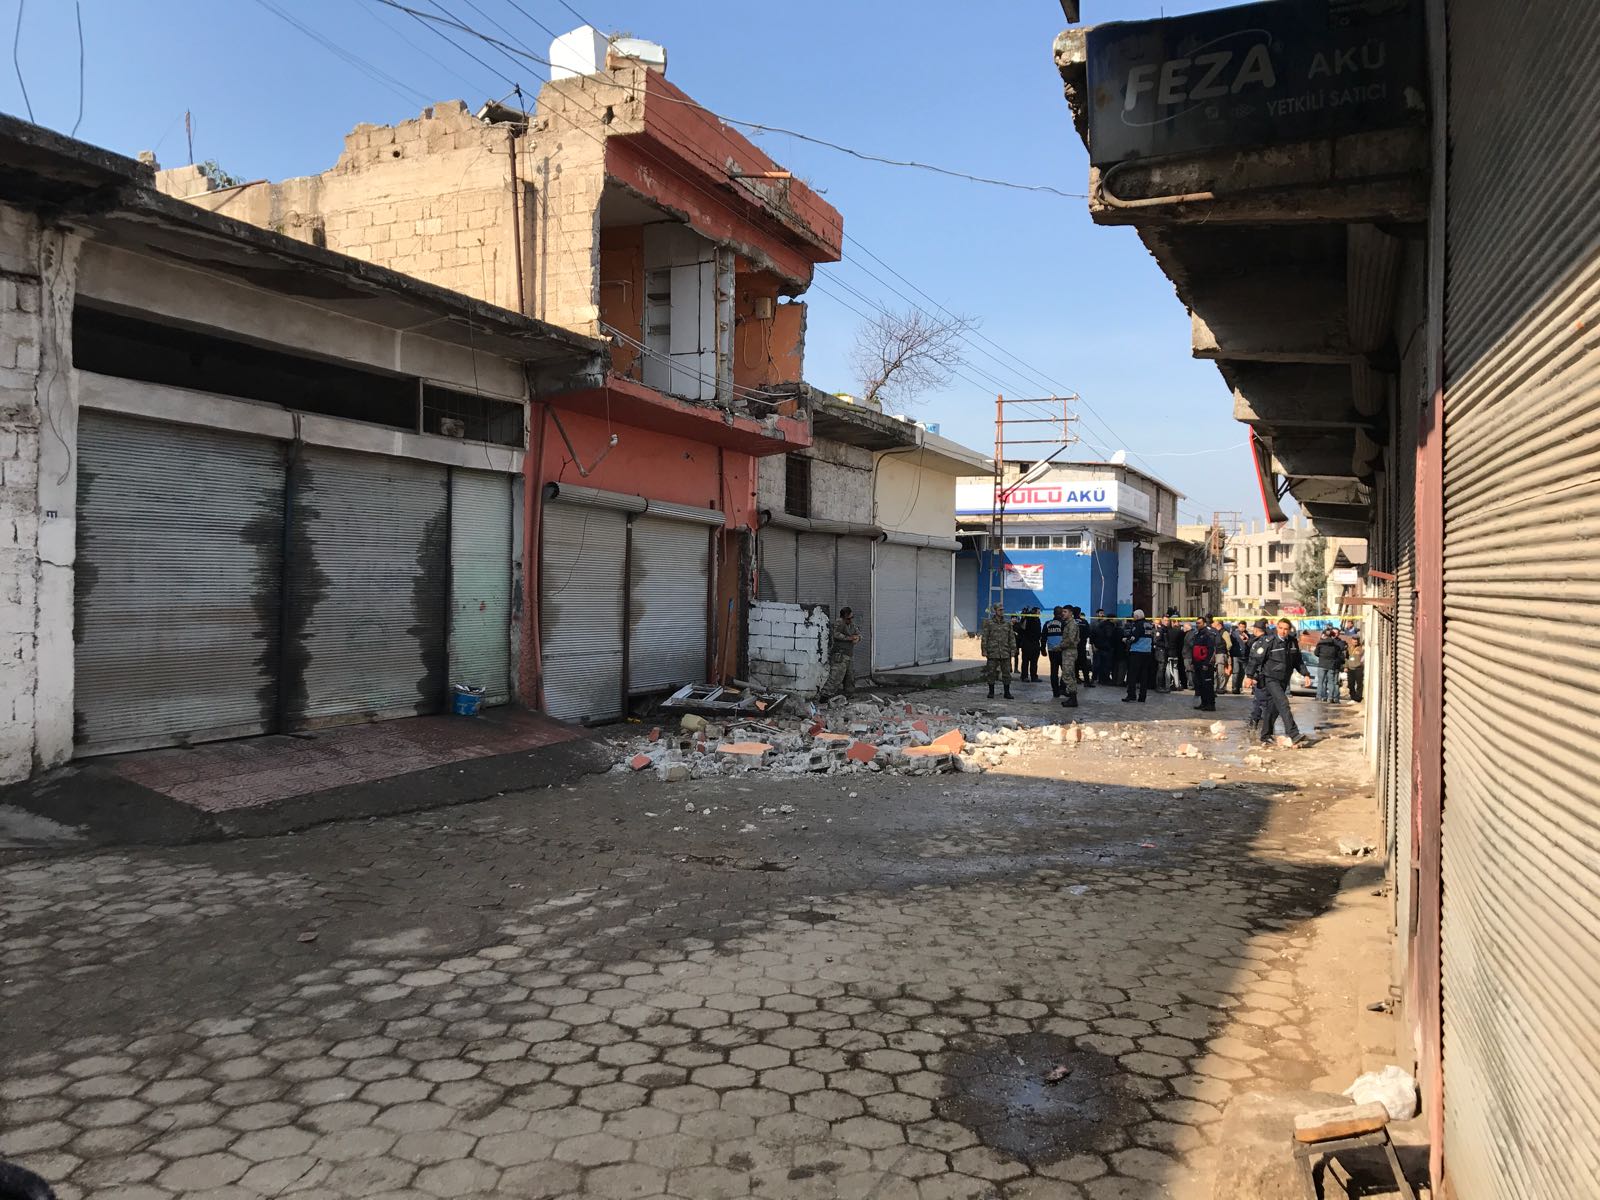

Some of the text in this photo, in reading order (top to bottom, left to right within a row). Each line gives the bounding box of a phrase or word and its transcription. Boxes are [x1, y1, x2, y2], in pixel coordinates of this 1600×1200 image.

[1124, 43, 1276, 112] FEZA
[1307, 38, 1387, 80] AKÜ
[1266, 88, 1325, 117] YETKİLİ
[1328, 81, 1387, 108] SATICI
[1066, 487, 1106, 503] AKÜ
